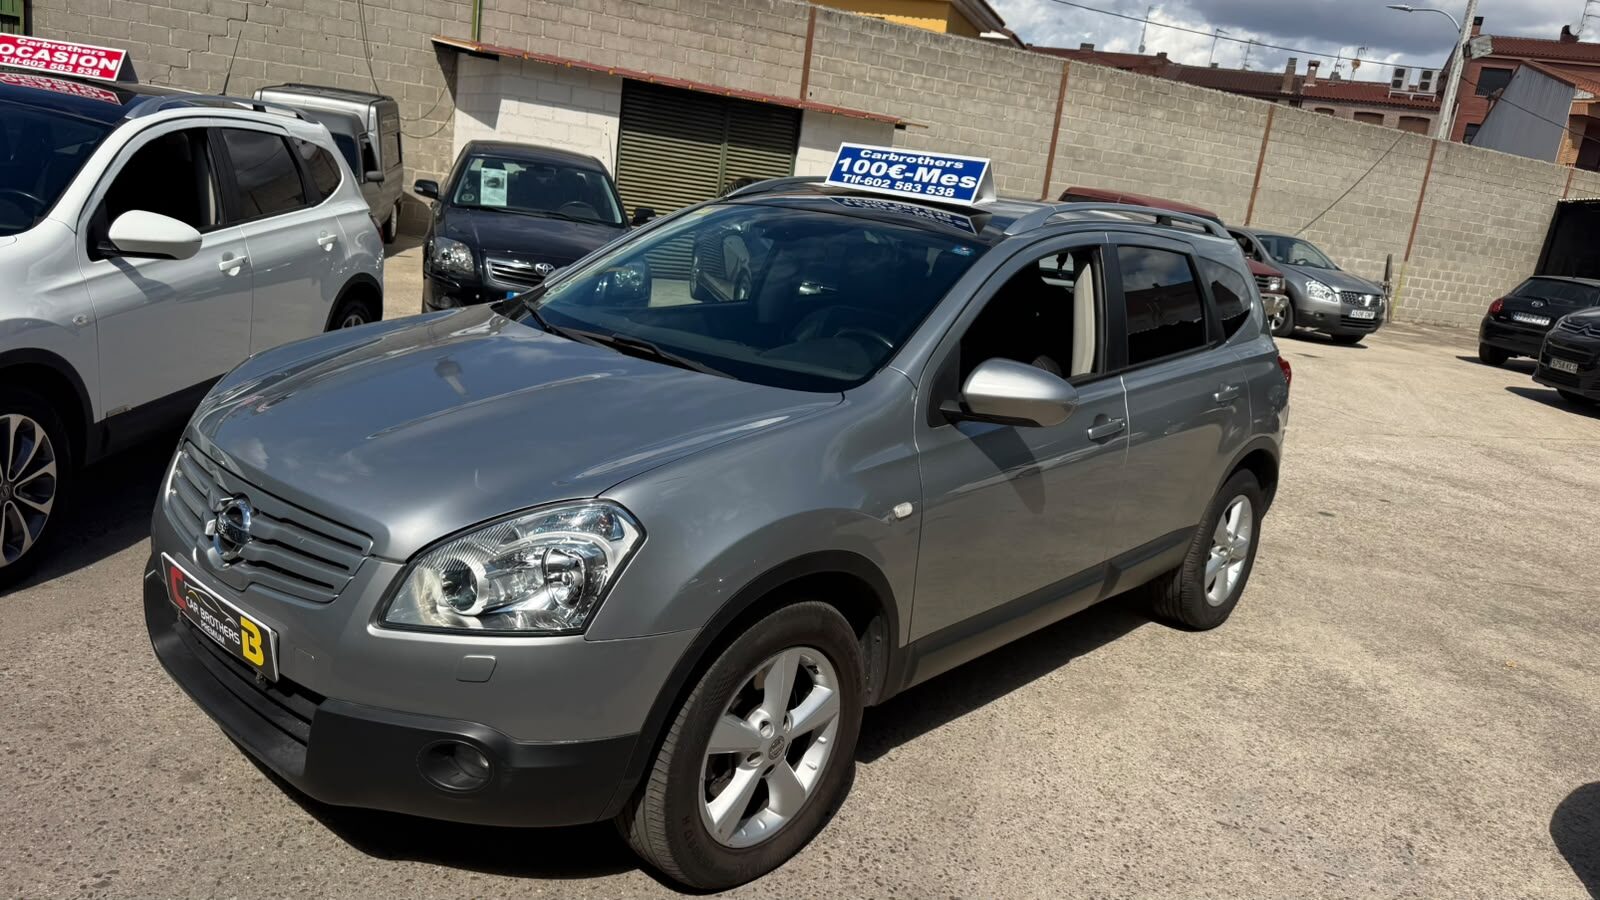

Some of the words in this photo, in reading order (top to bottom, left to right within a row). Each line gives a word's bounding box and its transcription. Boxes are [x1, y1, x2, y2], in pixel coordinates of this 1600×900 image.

[0, 43, 118, 70] OCASION
[17, 39, 106, 56] Carbrothers
[2, 56, 46, 68] Tlf-602
[50, 63, 73, 72] 583
[76, 67, 101, 76] 538
[860, 150, 964, 169] Carbrothers
[839, 158, 976, 188] 100€-Mes
[842, 173, 890, 188] Tlf-602
[894, 181, 922, 192] 583
[926, 185, 954, 197] 538
[185, 596, 199, 615] CAR
[200, 608, 240, 645] BROTHERS
[200, 619, 225, 643] PREMIUM
[240, 616, 265, 666] B
